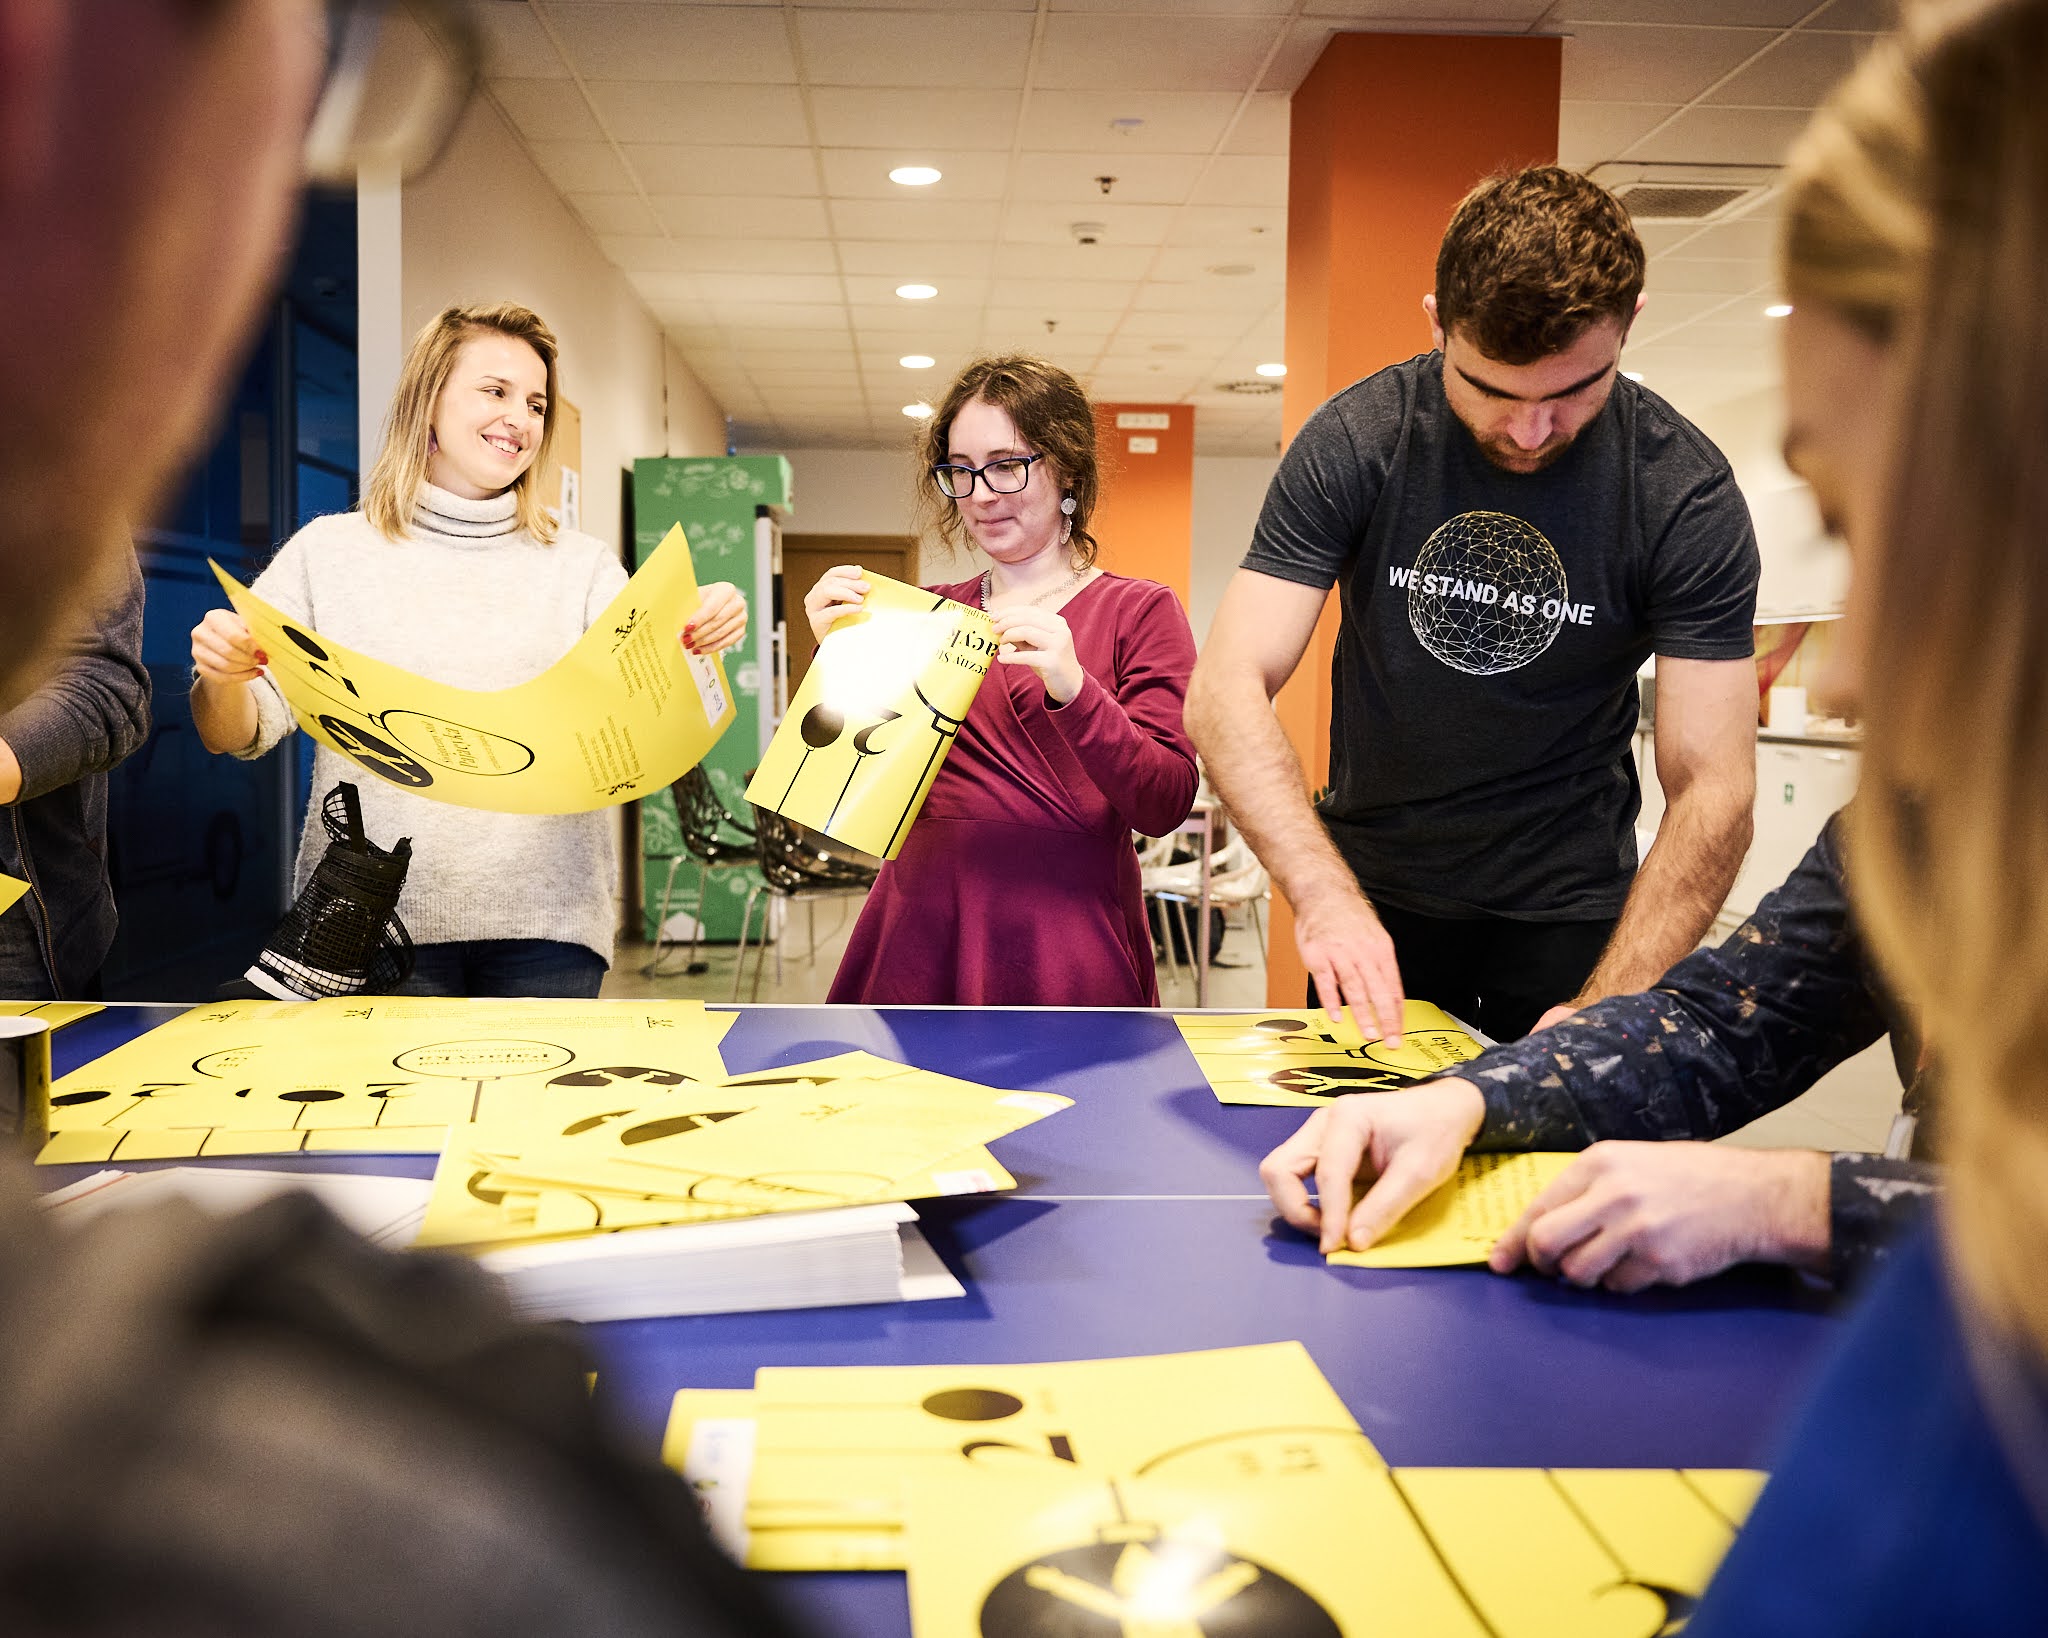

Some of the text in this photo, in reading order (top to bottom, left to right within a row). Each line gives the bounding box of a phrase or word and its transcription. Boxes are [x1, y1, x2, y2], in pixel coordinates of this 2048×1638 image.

[1389, 566, 1596, 626] WE STAND AS ONE
[946, 628, 999, 657] acyk
[953, 655, 987, 676] eczny
